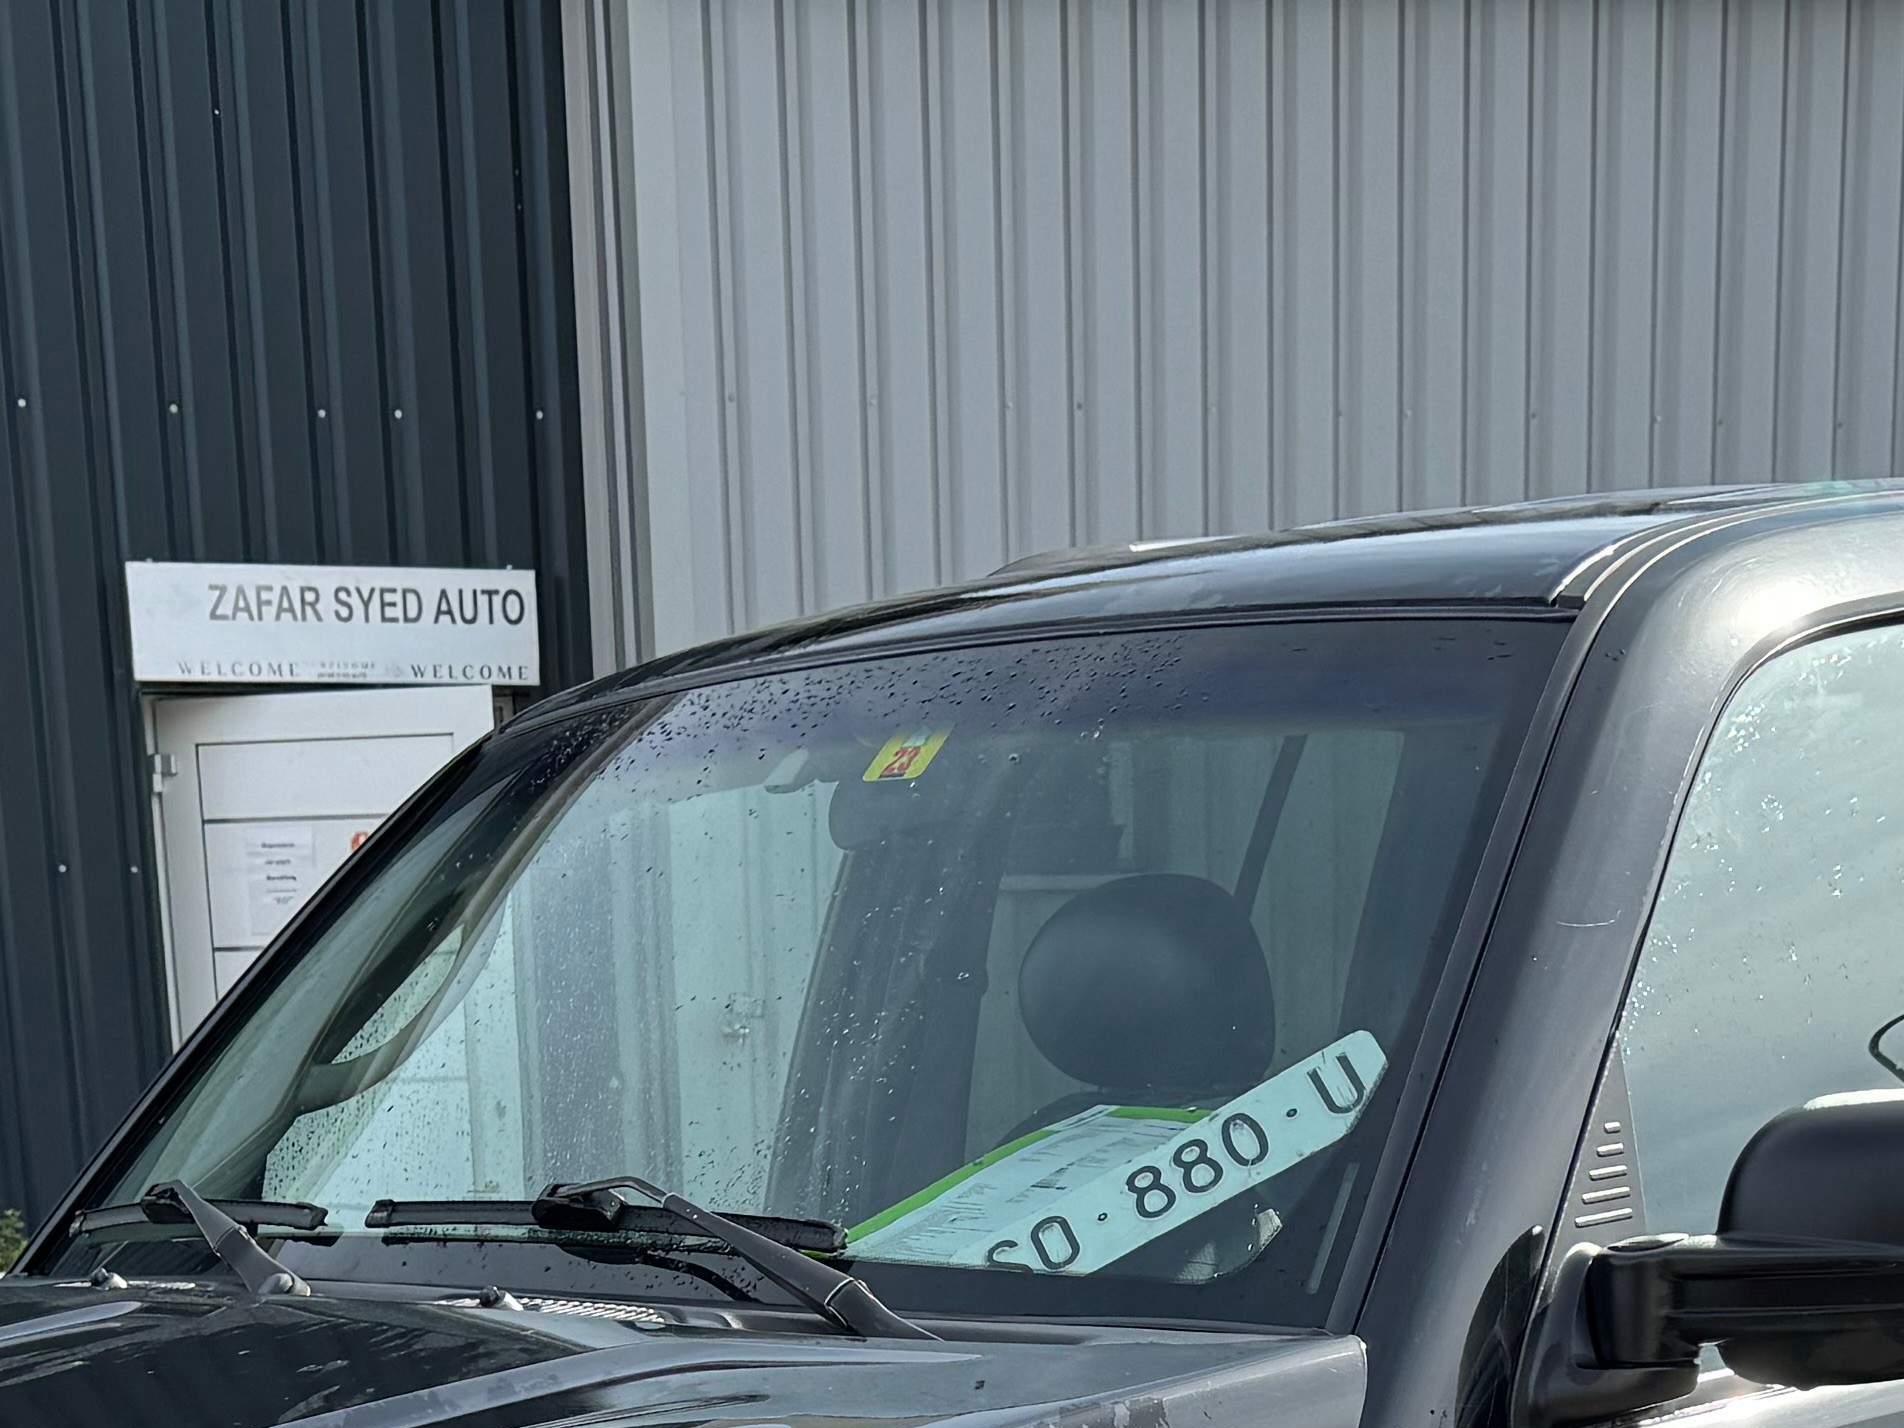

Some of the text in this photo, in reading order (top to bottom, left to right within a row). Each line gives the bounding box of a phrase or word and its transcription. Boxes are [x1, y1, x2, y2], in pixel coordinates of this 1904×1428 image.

[207, 583, 526, 627] ZAFAR SYED AUTO
[176, 661, 300, 679] WELCOME
[410, 663, 530, 681] WELCOME
